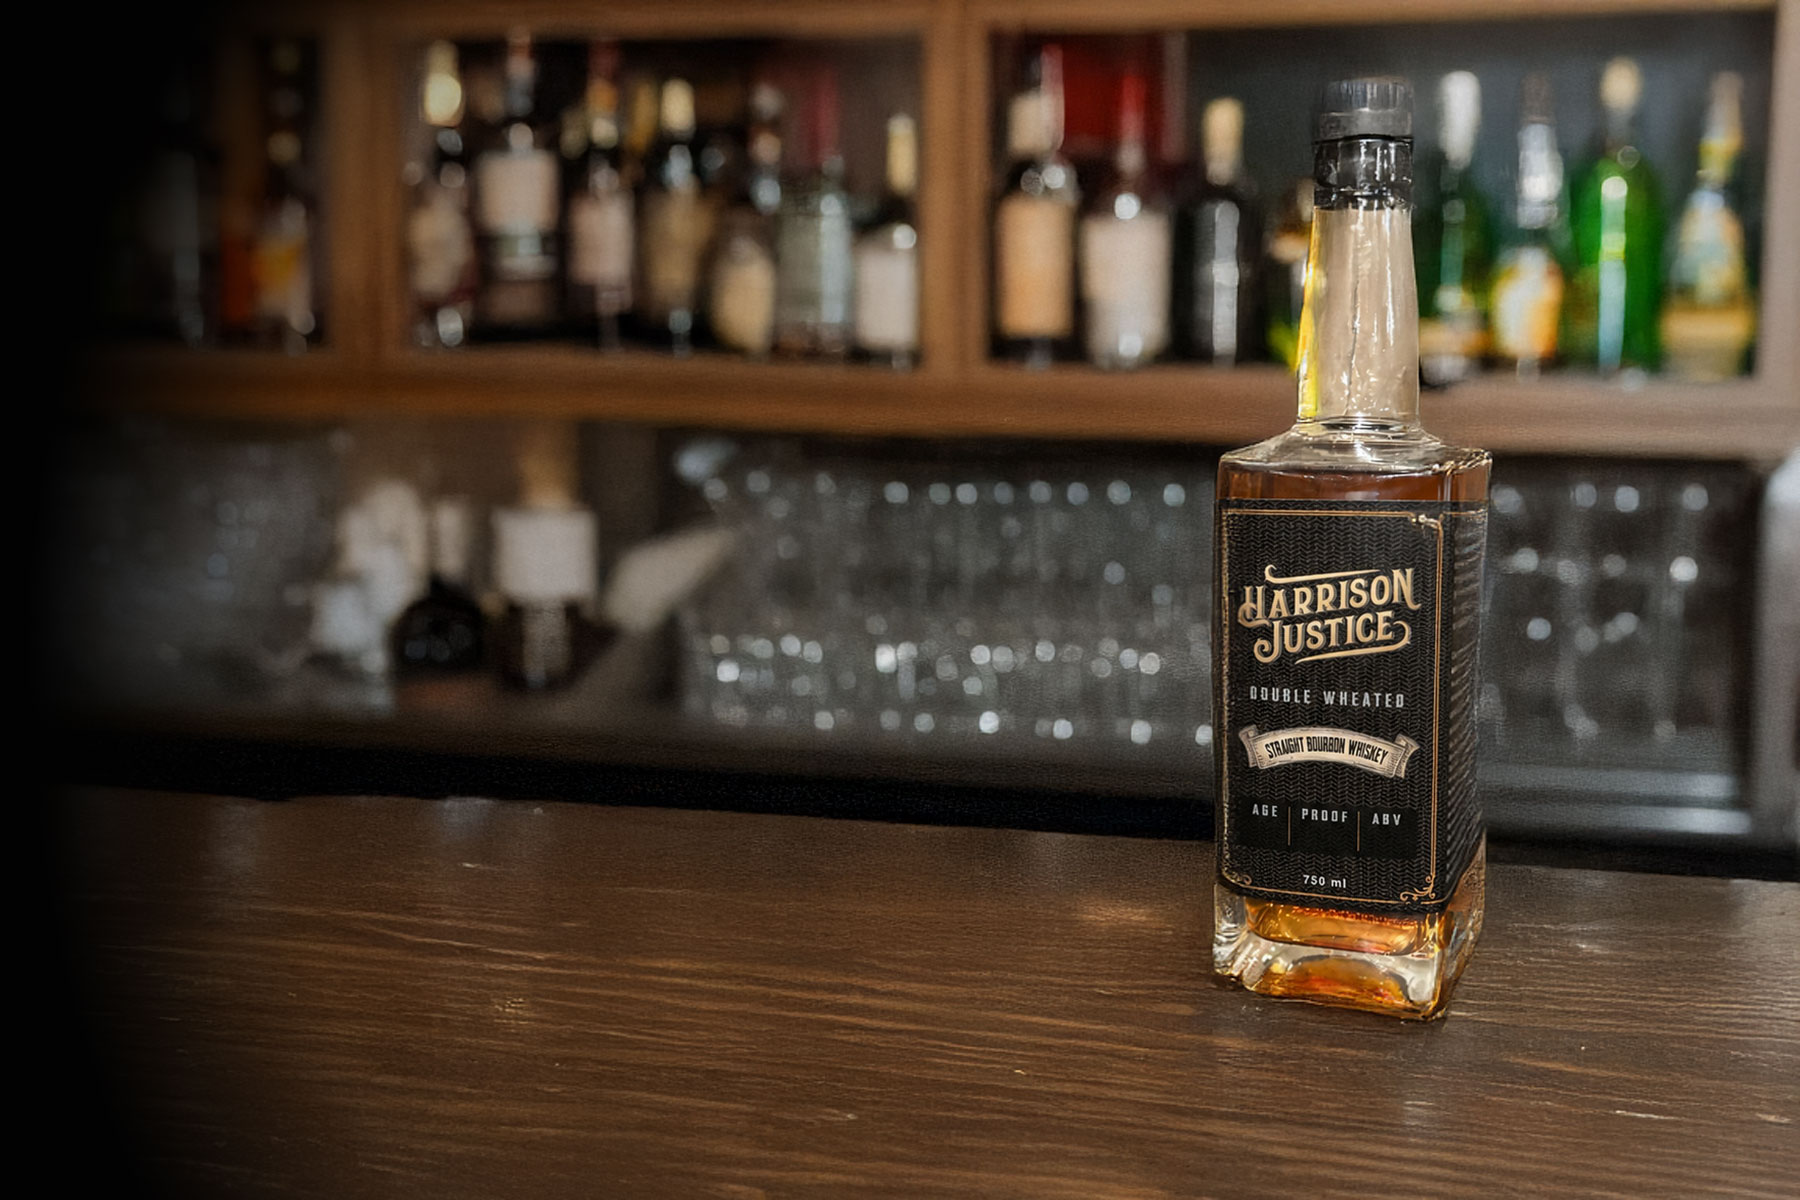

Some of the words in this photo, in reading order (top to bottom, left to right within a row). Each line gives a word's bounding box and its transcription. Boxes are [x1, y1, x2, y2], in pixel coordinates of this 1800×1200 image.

[1238, 565, 1421, 628] HARRISON
[1253, 610, 1411, 664] JUSTICE
[1250, 685, 1311, 704] DOUBLE
[1323, 690, 1404, 708] WHEATED
[1264, 736, 1304, 759] STRAIGHT
[1306, 736, 1345, 754] BOURBON
[1348, 741, 1389, 765] WHISKEY
[1252, 803, 1278, 818] AGE
[1301, 808, 1348, 823] PROOF
[1372, 812, 1401, 826] ABV
[1303, 874, 1325, 887] 750
[1331, 878, 1346, 889] ml
